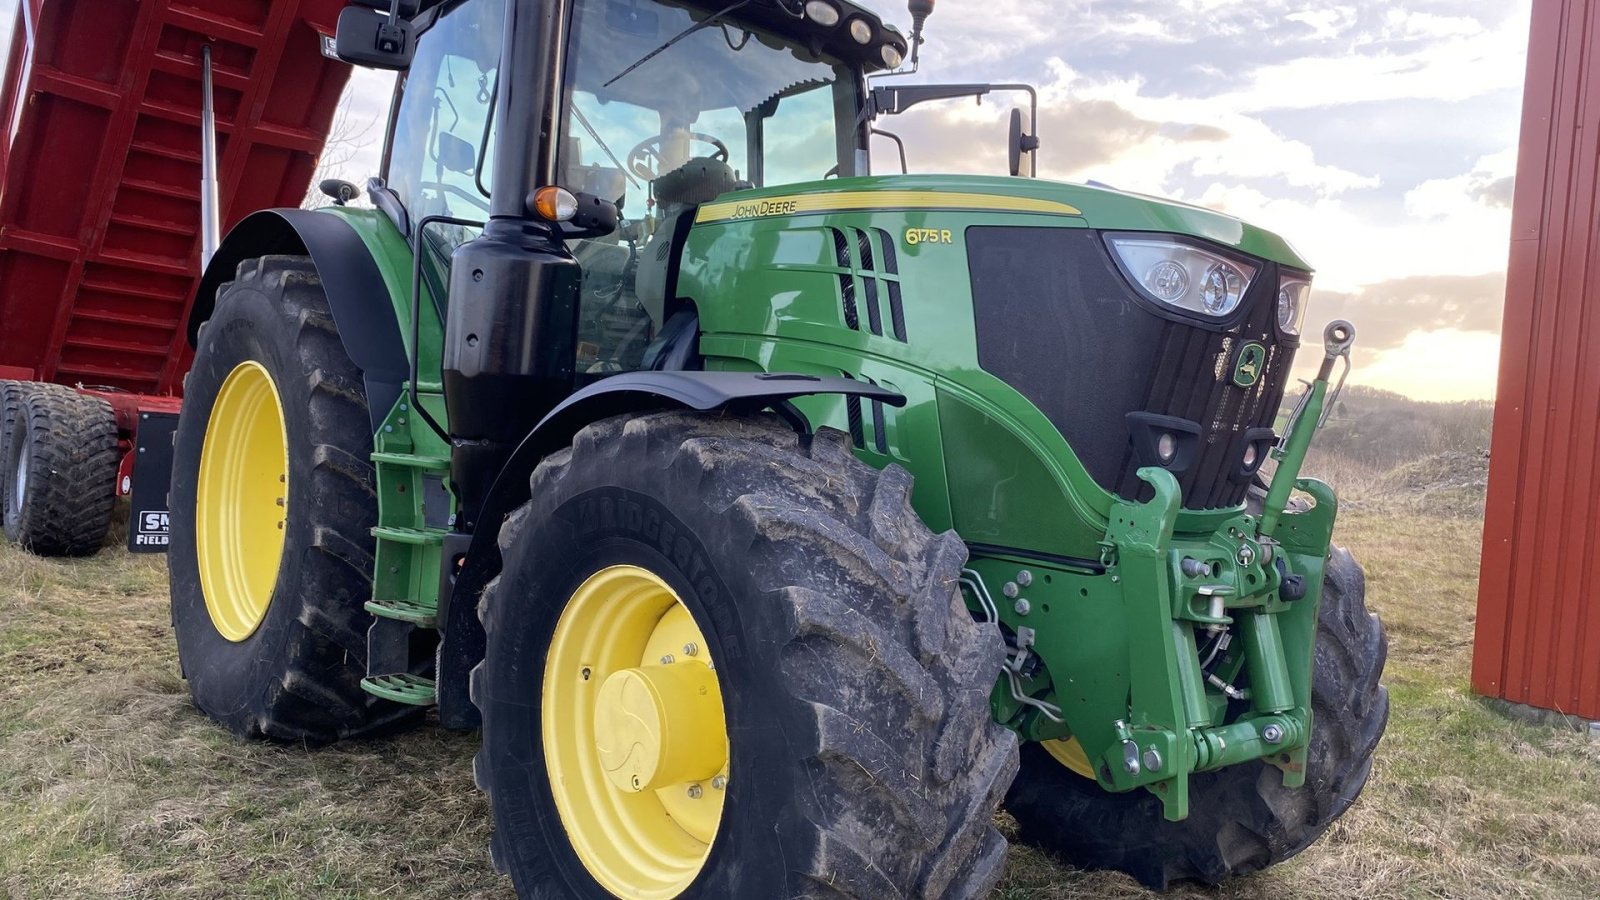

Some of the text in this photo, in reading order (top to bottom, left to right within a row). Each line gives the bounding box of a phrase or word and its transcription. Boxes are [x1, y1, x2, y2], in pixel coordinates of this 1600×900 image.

[732, 201, 797, 217] JOHN DEERE
[136, 535, 169, 544] FIELD
